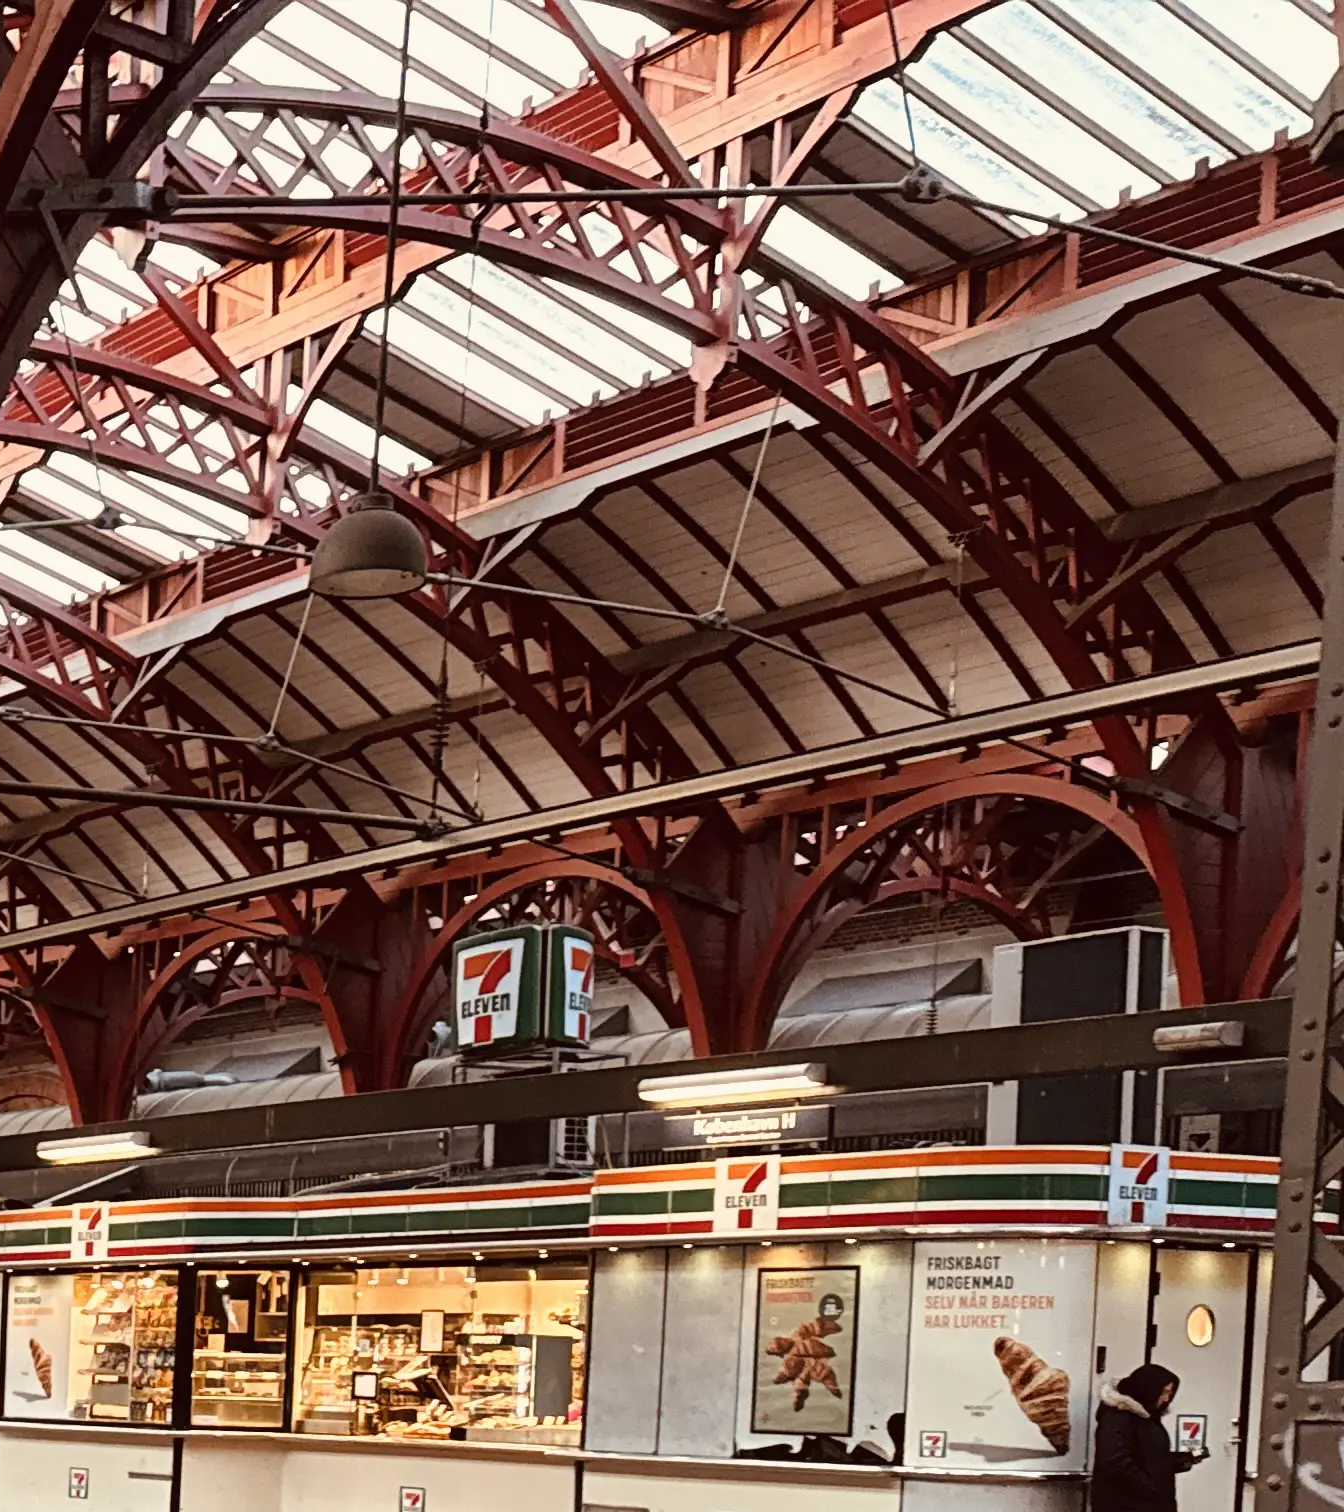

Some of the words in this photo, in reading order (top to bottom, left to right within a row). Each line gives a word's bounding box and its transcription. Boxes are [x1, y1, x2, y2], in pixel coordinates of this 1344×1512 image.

[464, 948, 512, 1043] 7
[728, 1162, 767, 1229] 7
[1122, 1151, 1159, 1223] 7
[79, 1208, 102, 1256] 7
[926, 1275, 1015, 1290] MORGENMAD
[927, 1256, 1001, 1270] FRISKBAGT
